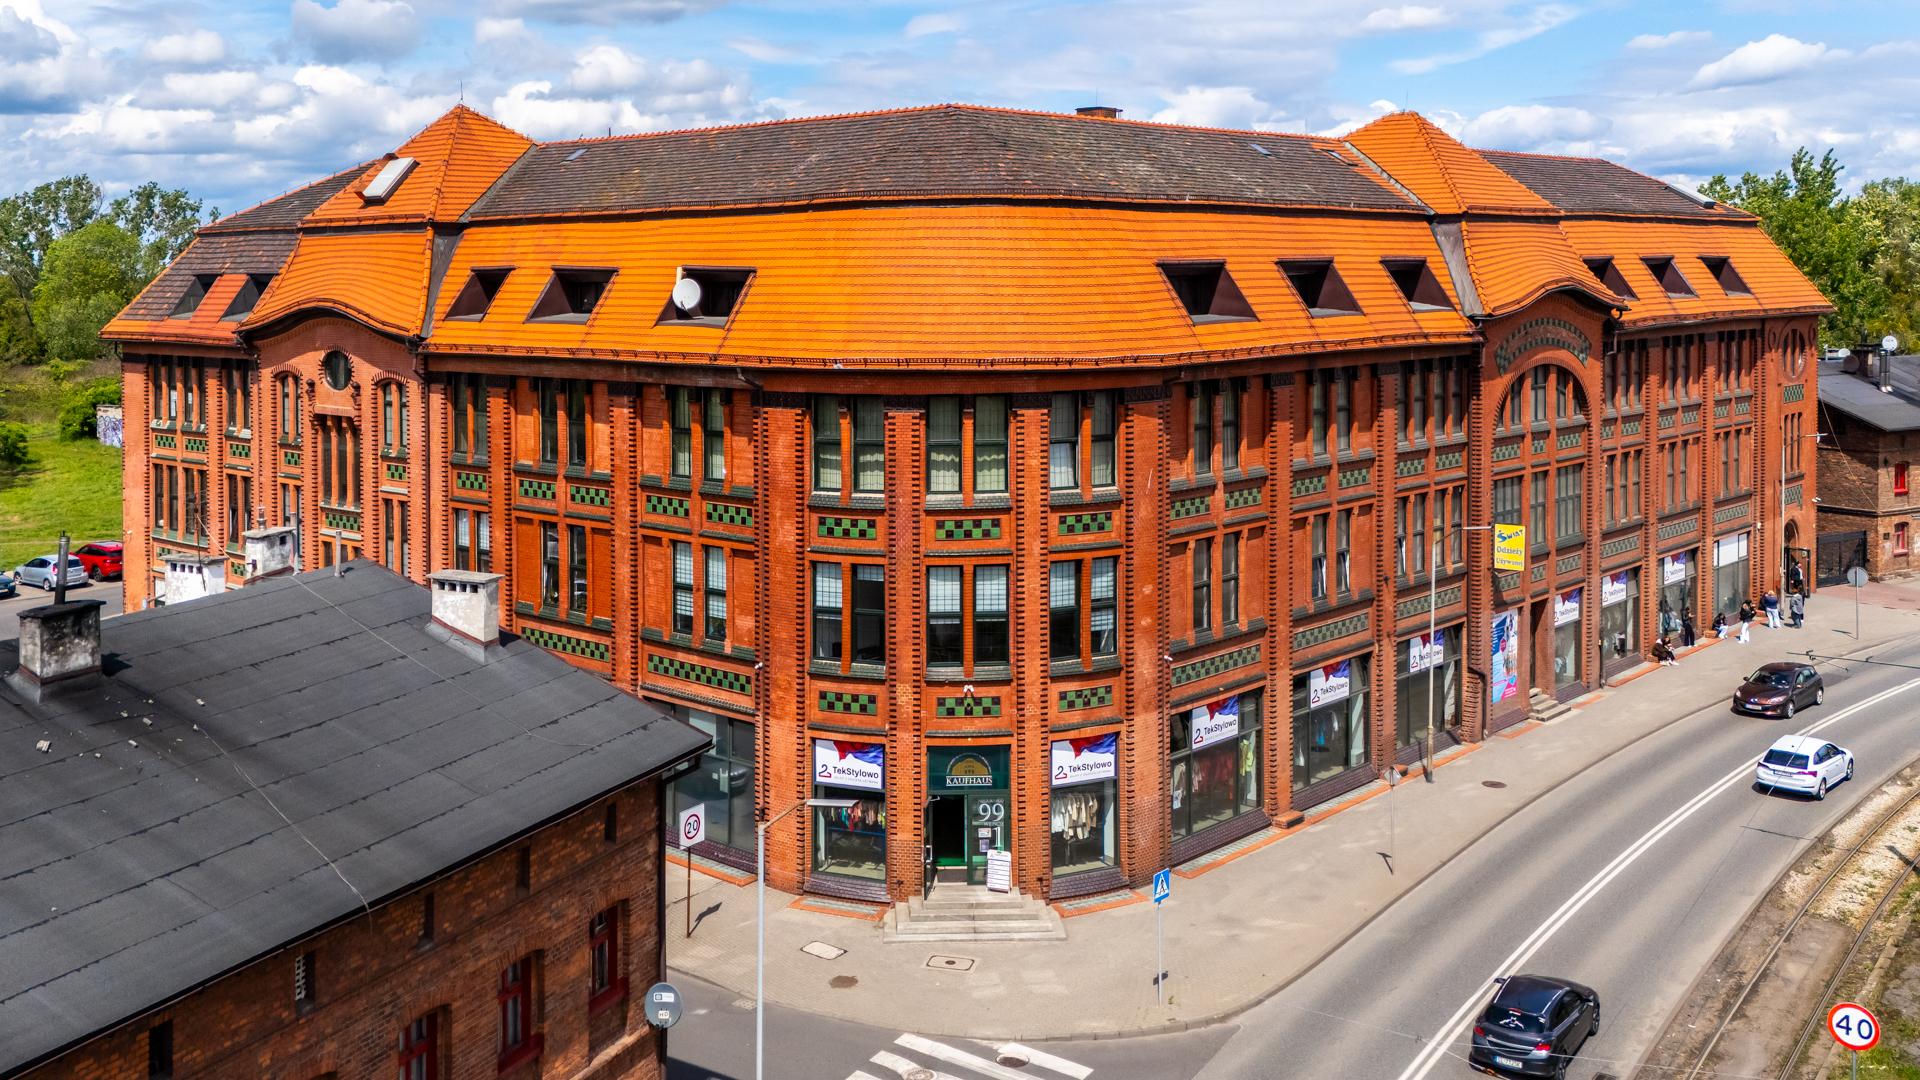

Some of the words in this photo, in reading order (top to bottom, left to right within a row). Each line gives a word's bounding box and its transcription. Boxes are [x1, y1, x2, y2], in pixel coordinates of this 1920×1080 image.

[1204, 719, 1237, 735] TekStylowo
[832, 766, 879, 779] TekStylowo
[1068, 761, 1112, 773] TekStylowo
[946, 777, 992, 785] KAUFHAUS
[978, 803, 1005, 822] 99
[687, 820, 698, 834] 20
[1835, 1014, 1873, 1040] 40
